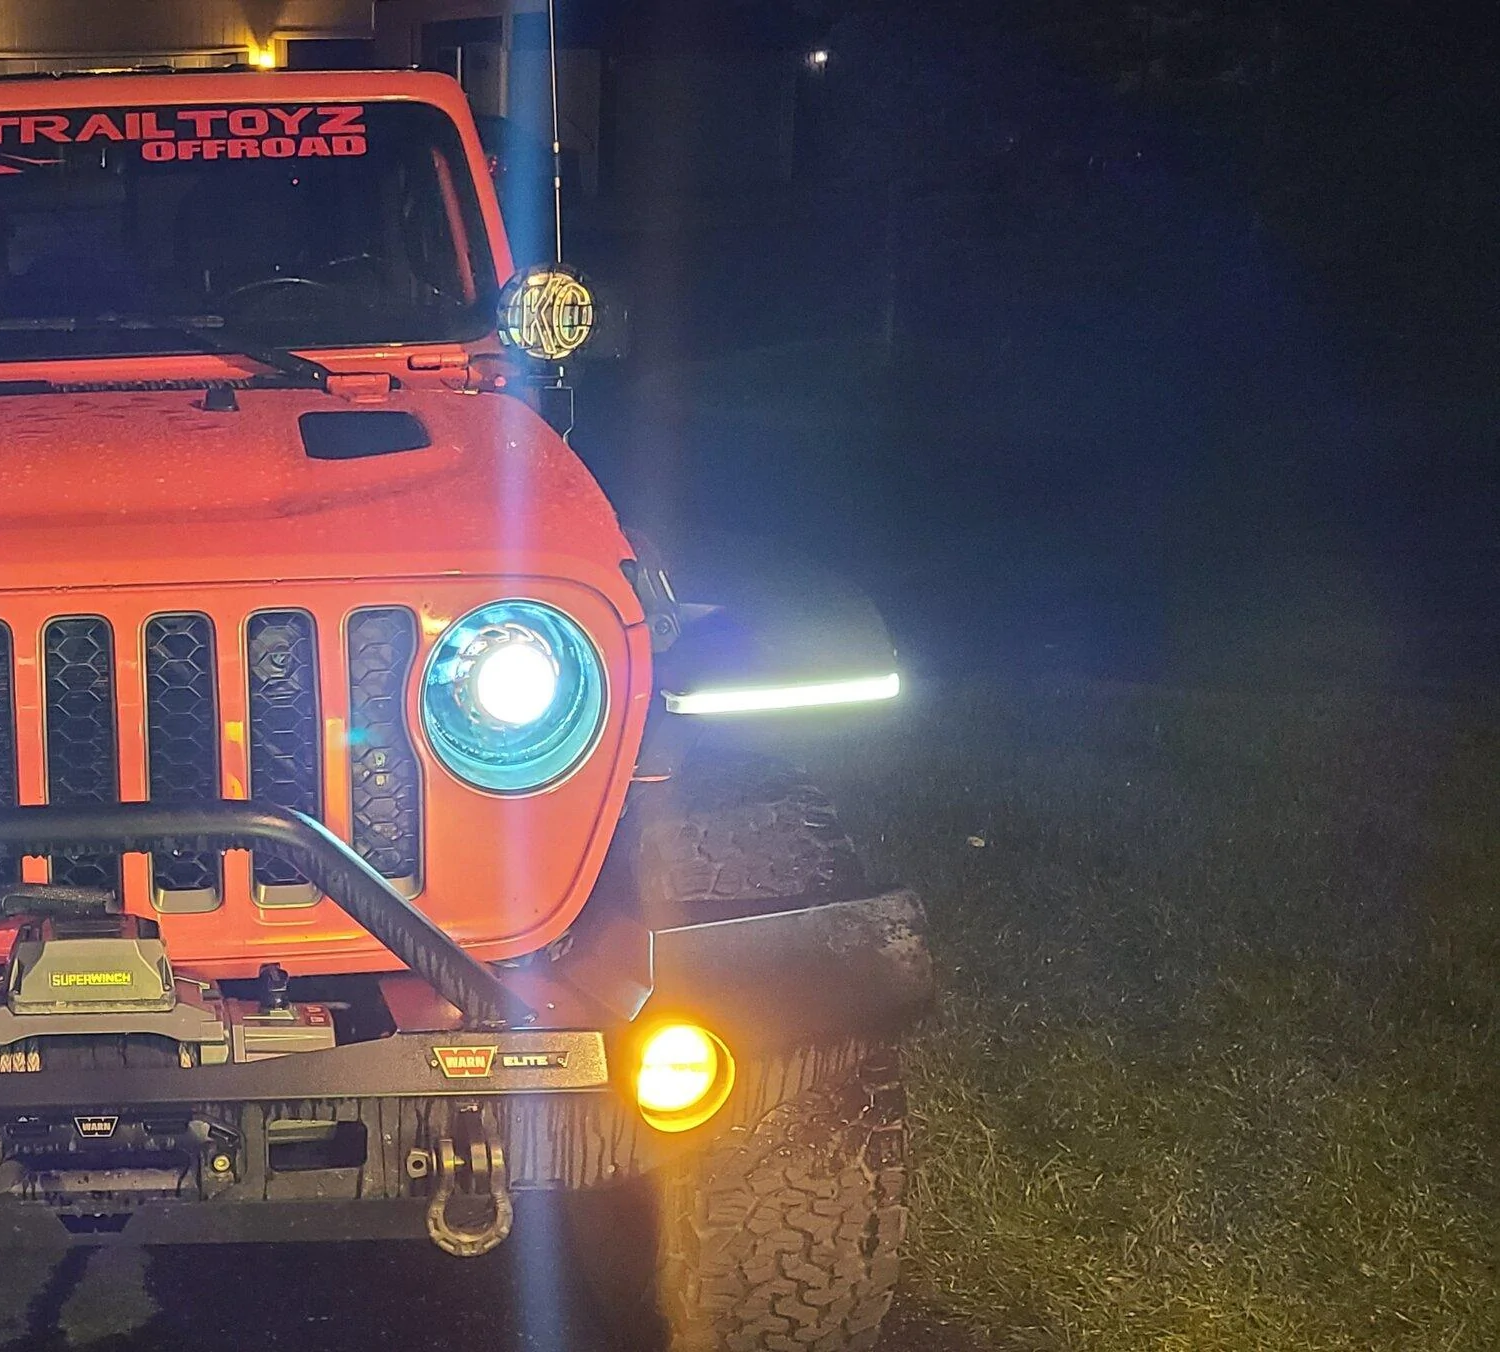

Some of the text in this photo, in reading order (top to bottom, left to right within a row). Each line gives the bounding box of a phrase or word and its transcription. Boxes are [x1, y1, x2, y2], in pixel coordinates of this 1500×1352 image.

[142, 135, 367, 162] OFFROAD
[522, 277, 592, 355] KC
[52, 972, 131, 986] SUPERWINCH
[445, 1055, 548, 1069] WARN ELITE
[82, 1122, 111, 1132] WARN
